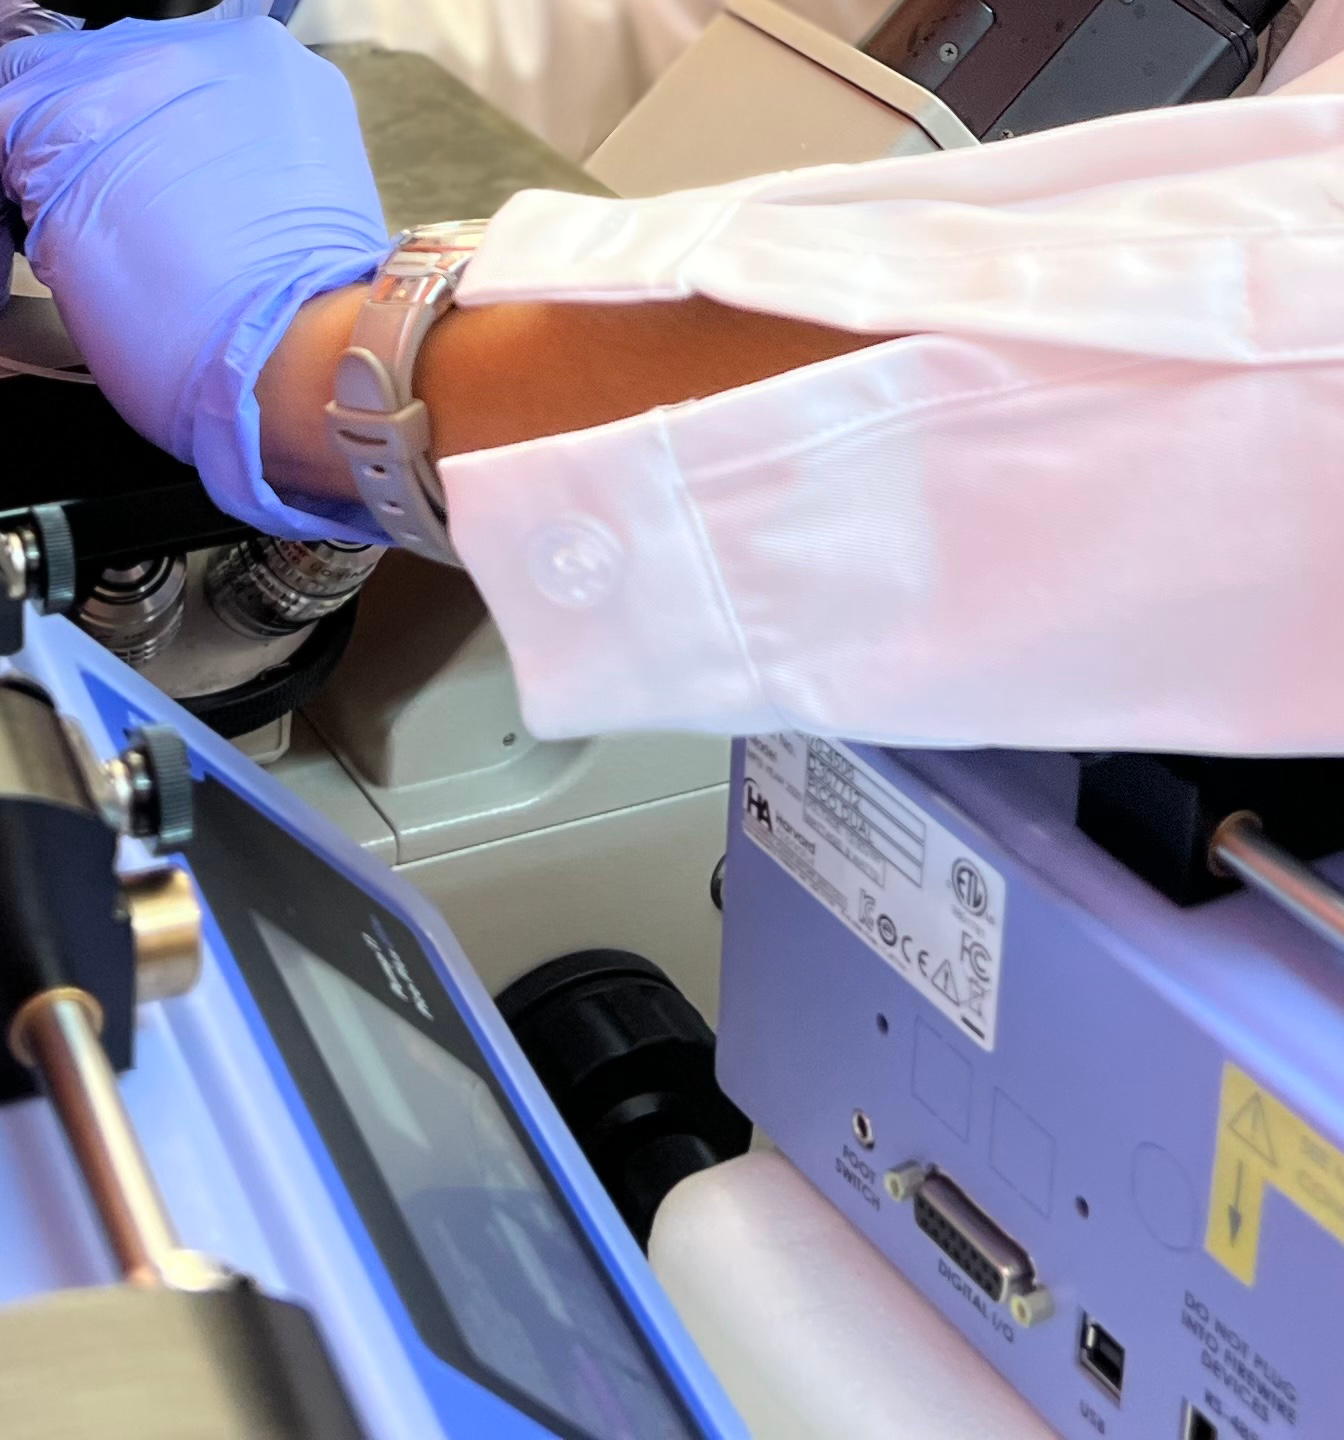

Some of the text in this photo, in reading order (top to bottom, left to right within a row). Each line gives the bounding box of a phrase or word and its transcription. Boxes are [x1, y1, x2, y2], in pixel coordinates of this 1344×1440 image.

[775, 812, 816, 856] Harvard
[836, 1157, 881, 1211] SWITCH
[843, 1144, 876, 1184] FOOT
[937, 1257, 1015, 1343] DIGITAL I/O
[1181, 1309, 1297, 1426] INTO FIREWIRE
[1184, 1289, 1297, 1402] DO NOT PLUG
[1078, 1398, 1106, 1435] USB
[1200, 1348, 1270, 1423] DEVICES
